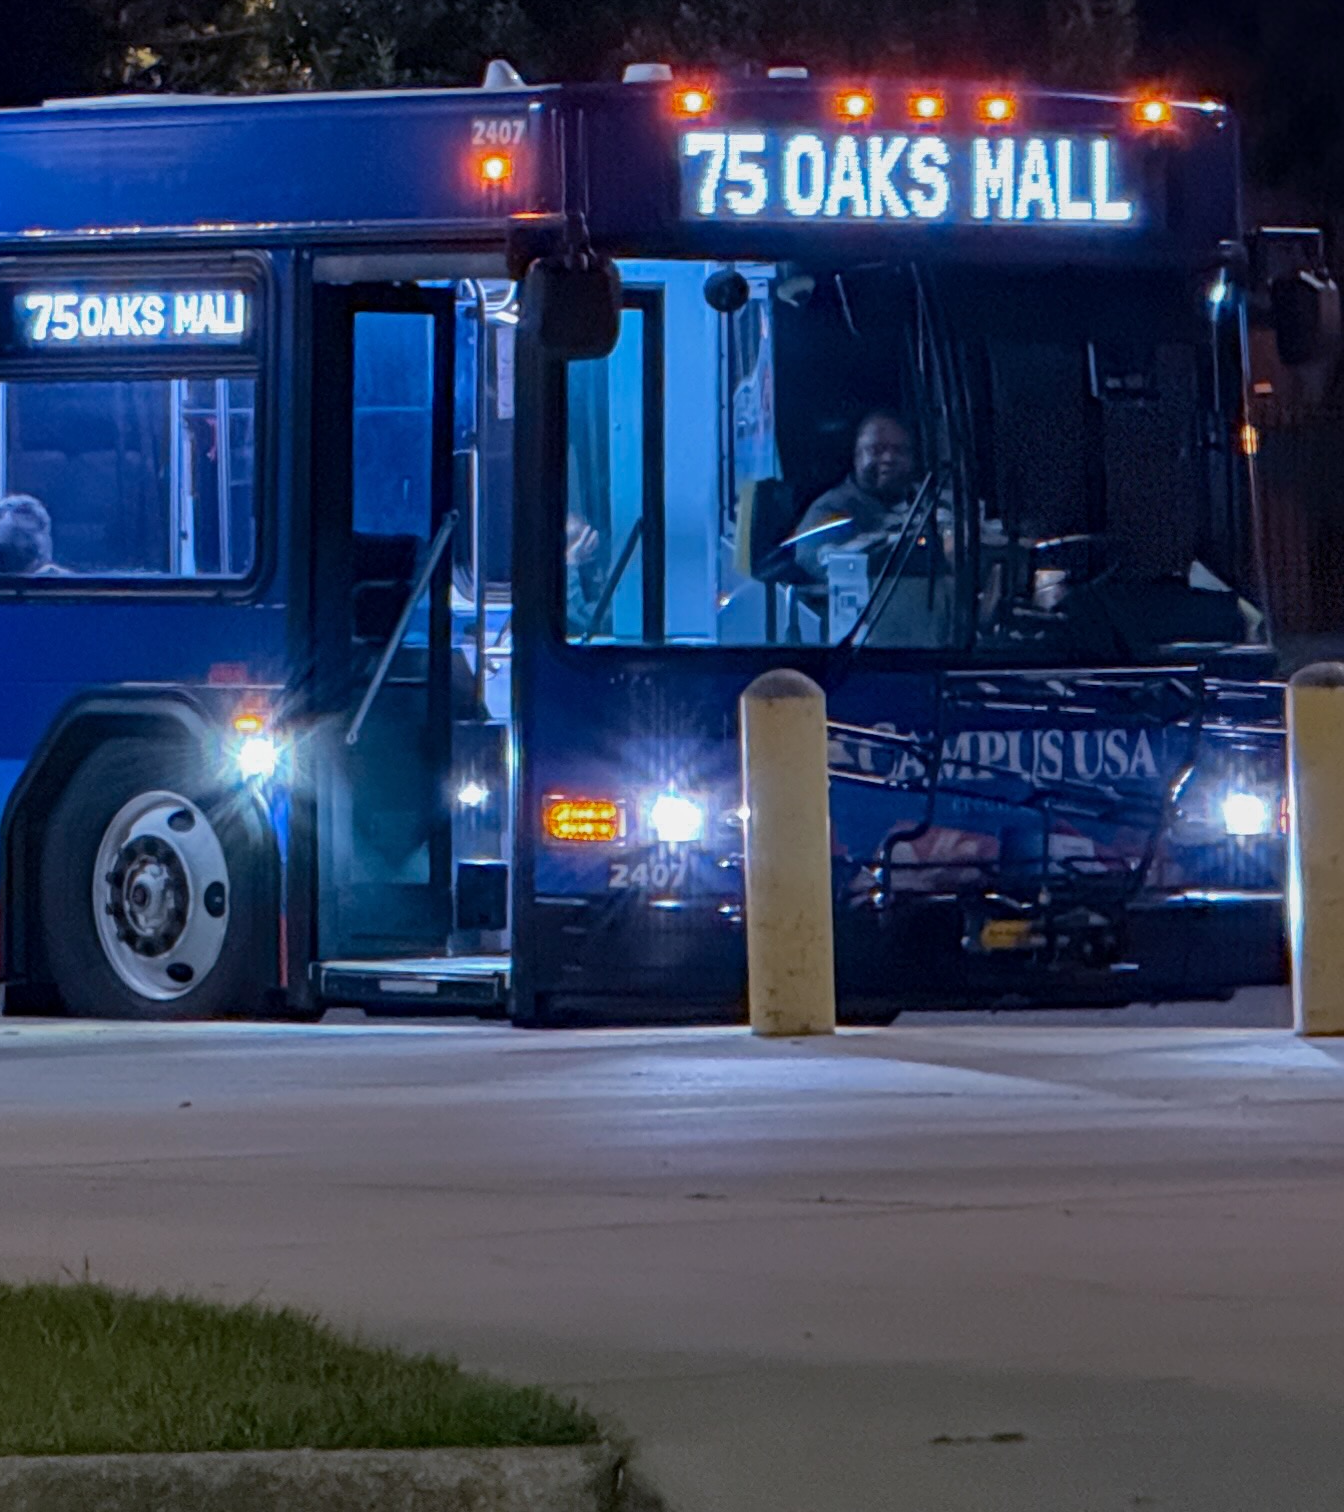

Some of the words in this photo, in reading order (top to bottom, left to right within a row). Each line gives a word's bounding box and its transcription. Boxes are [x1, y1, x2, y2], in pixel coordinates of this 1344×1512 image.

[472, 120, 526, 145] 2407
[684, 132, 769, 216] 75
[781, 133, 952, 219] OAKS
[970, 136, 1133, 222] MALL
[25, 293, 80, 340] 75
[79, 294, 166, 337] OAKS
[1072, 728, 1161, 781] USA
[608, 863, 686, 888] 2407
